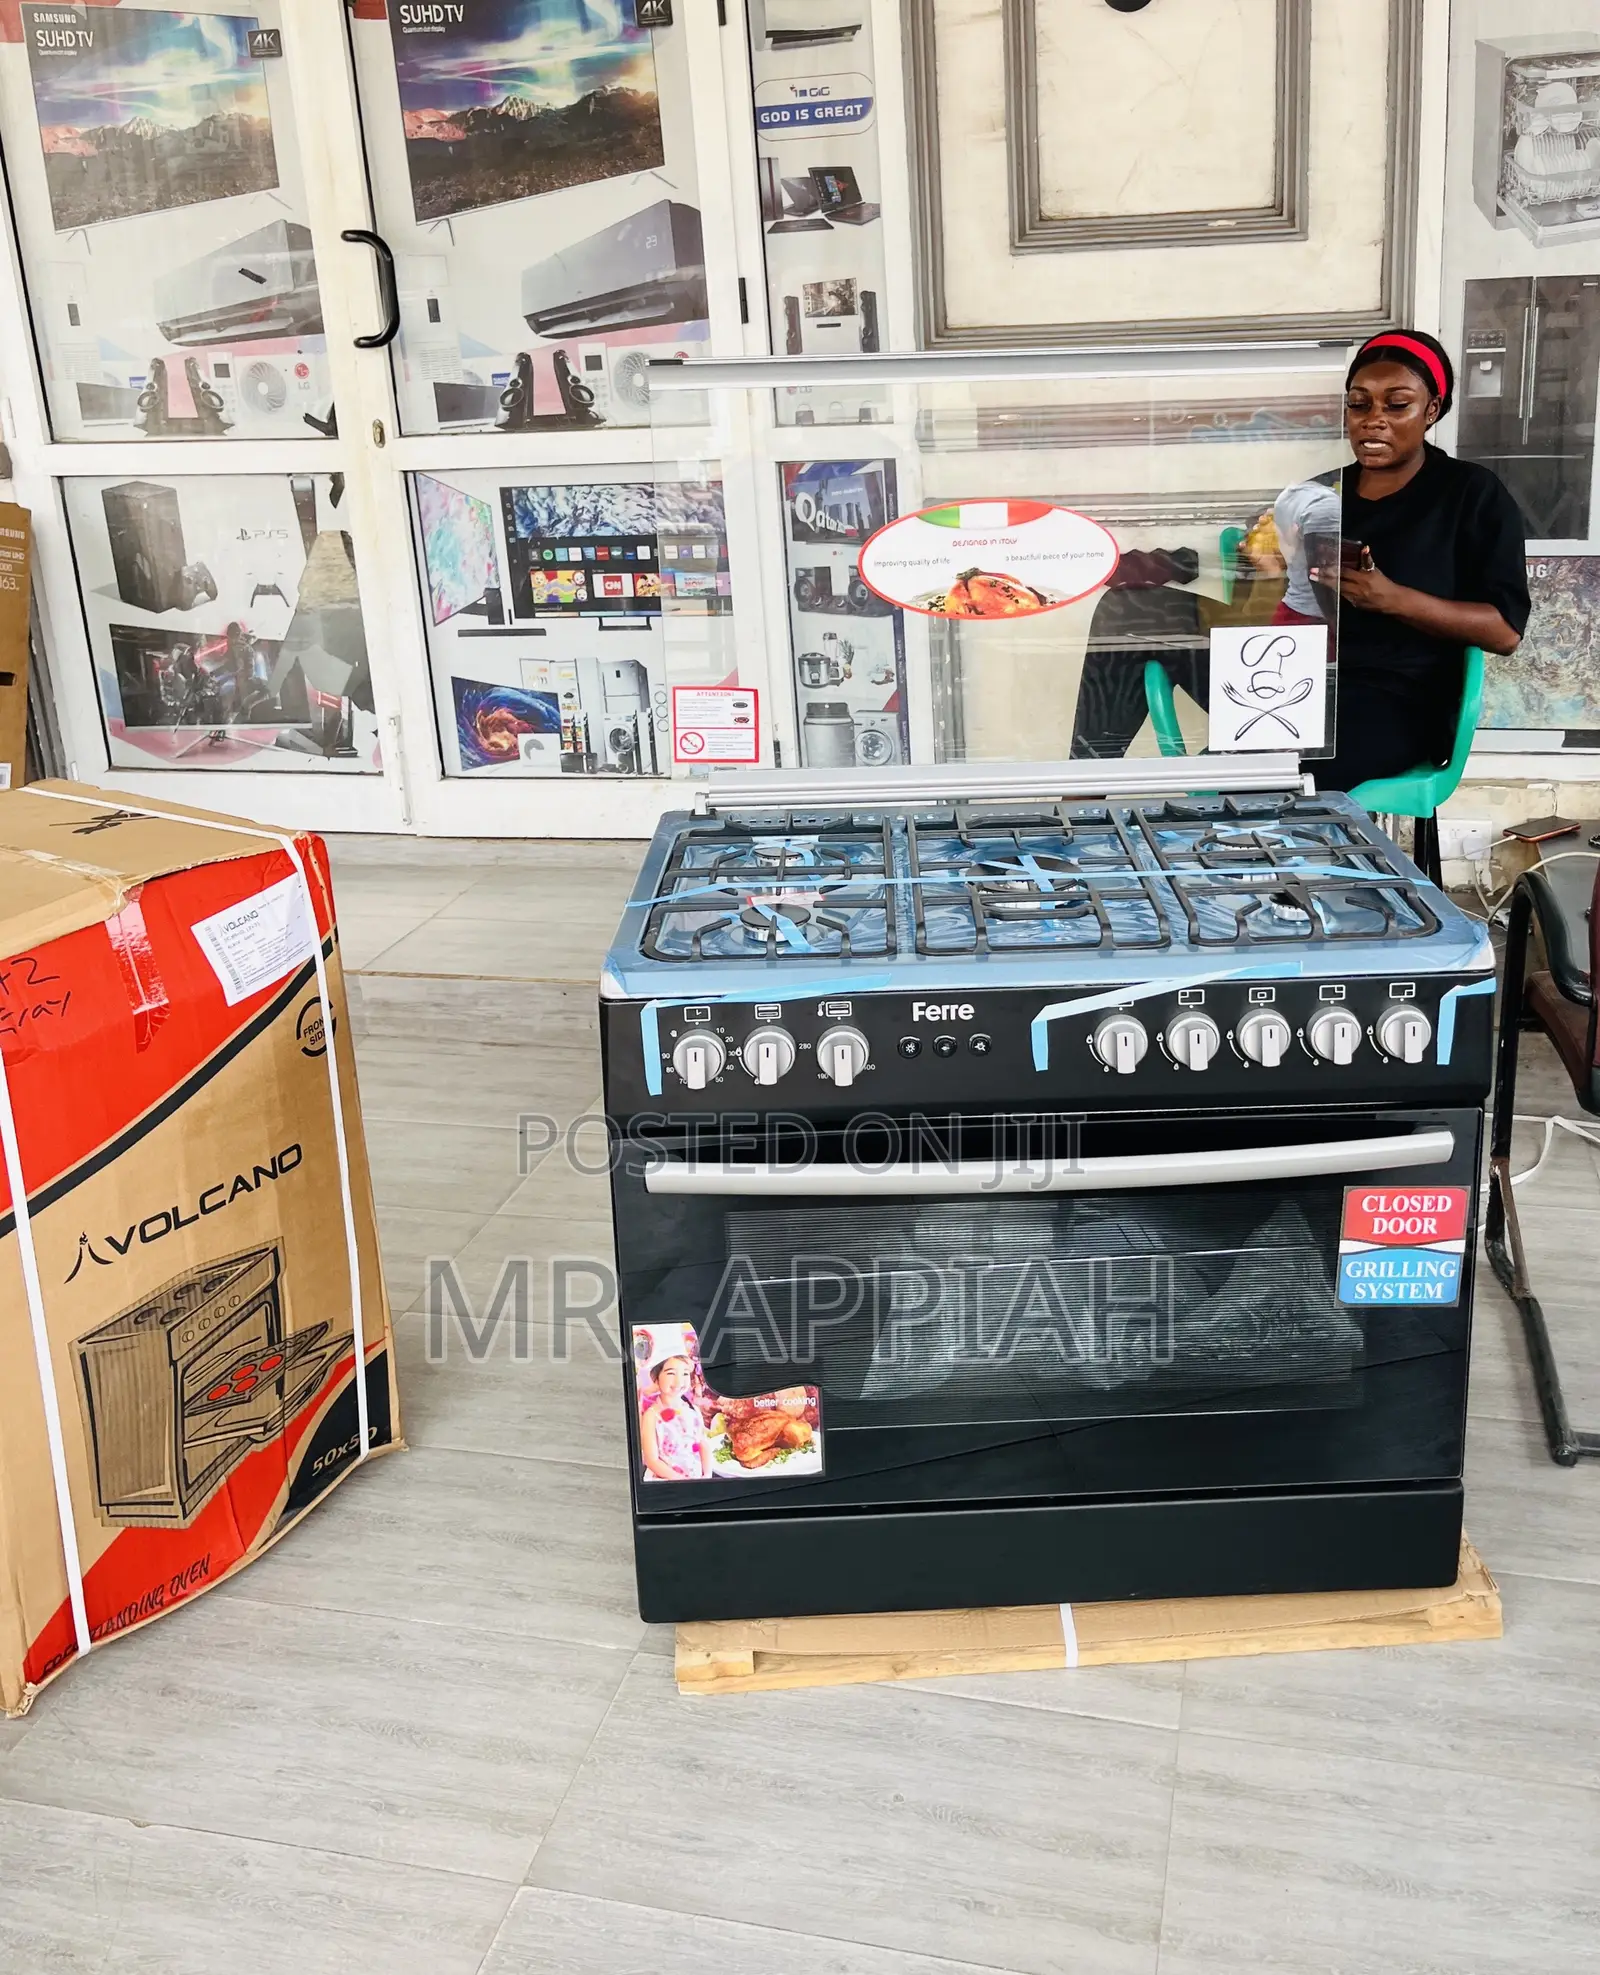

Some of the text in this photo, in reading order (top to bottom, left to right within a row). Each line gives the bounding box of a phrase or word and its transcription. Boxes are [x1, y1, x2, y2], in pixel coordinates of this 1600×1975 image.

[400, 4, 464, 24] SUHD TV
[640, 0, 667, 16] 4K
[33, 12, 77, 24] SAMSUNG
[36, 29, 94, 47] SUHD TV
[253, 32, 276, 48] 4K
[760, 104, 863, 123] GOD IS GREAT
[252, 528, 289, 539] PS5
[908, 558, 931, 567] quality
[932, 557, 939, 565] of
[940, 556, 951, 564] life
[1043, 553, 1061, 561] piece
[1062, 551, 1069, 559] of
[1069, 552, 1085, 560] your
[1086, 550, 1105, 559] home
[224, 909, 259, 932] VOLCANO
[912, 1001, 975, 1022] Ferre
[303, 1015, 325, 1038] FRON
[104, 1143, 303, 1256] VOLCANO
[1361, 1194, 1453, 1214] CLOSED
[1371, 1216, 1438, 1235] DOOR
[1345, 1260, 1457, 1278] GRILLING
[1354, 1282, 1445, 1300] SYSTEM
[753, 1394, 817, 1408] better cooking
[169, 1553, 211, 1597] OVEN
